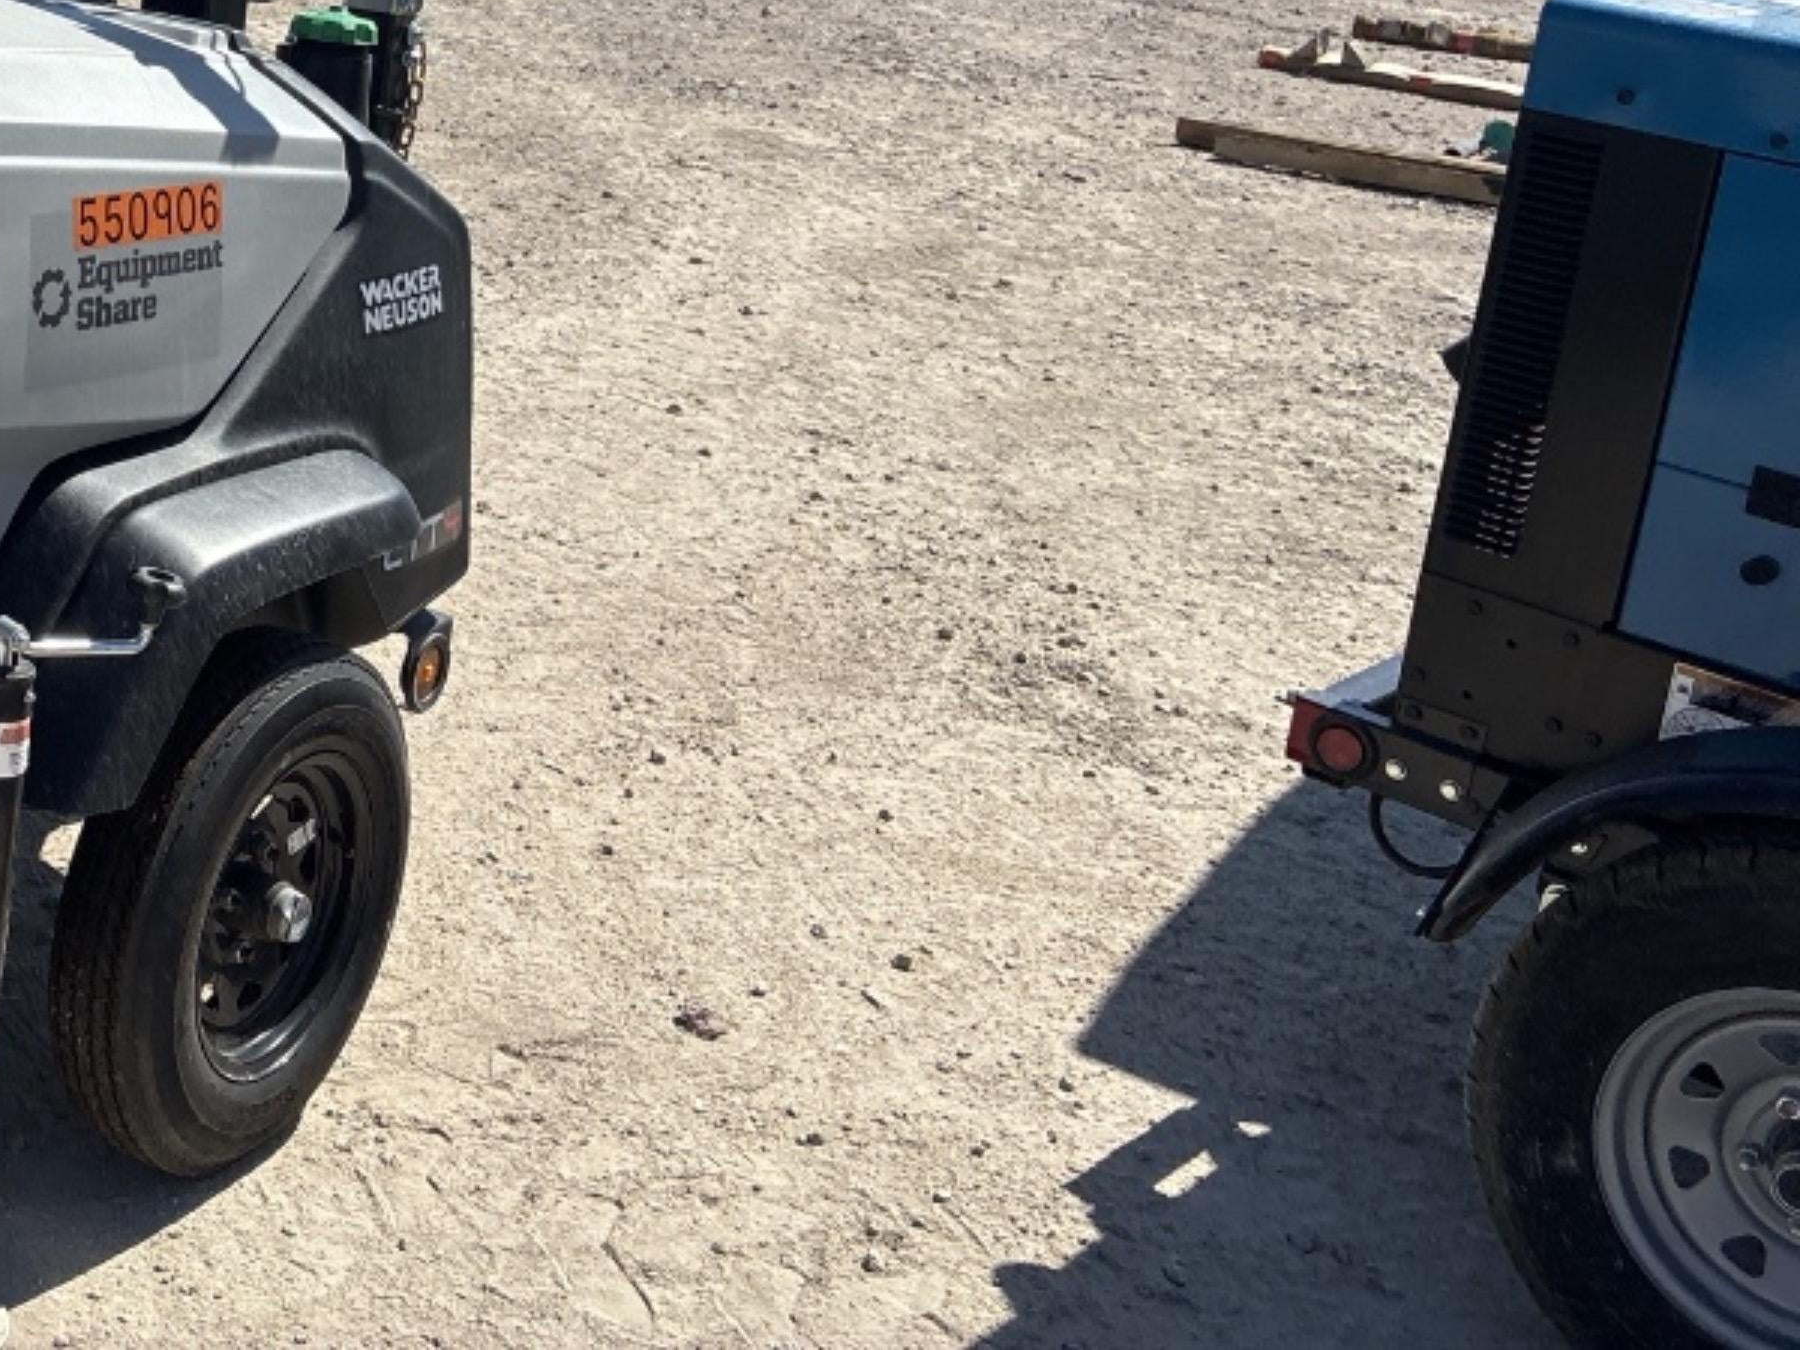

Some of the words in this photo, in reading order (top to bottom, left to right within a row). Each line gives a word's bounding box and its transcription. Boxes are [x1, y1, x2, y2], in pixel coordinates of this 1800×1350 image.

[80, 183, 218, 247] 550906
[77, 240, 224, 294] Equipment
[360, 263, 441, 307] WACKER
[76, 294, 158, 331] Share
[364, 291, 443, 335] NEUSON
